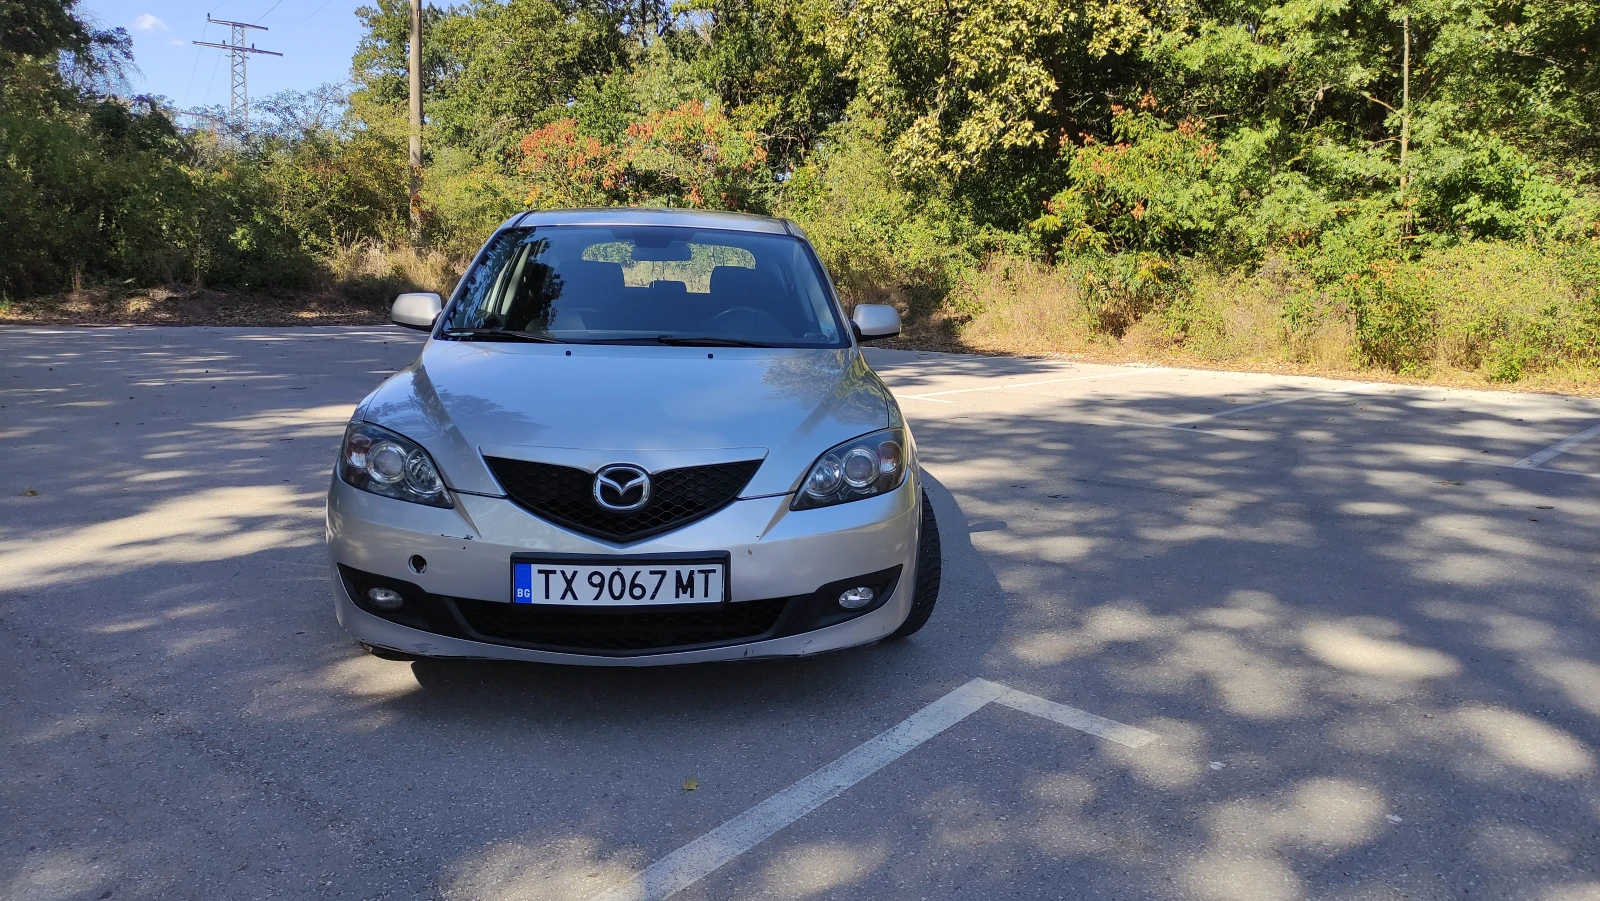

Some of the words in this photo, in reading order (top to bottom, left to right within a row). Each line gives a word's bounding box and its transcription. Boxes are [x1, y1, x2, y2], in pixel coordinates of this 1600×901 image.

[517, 588, 530, 598] BG
[537, 569, 578, 600] TX
[587, 570, 667, 601] 9067
[674, 568, 717, 599] MT
